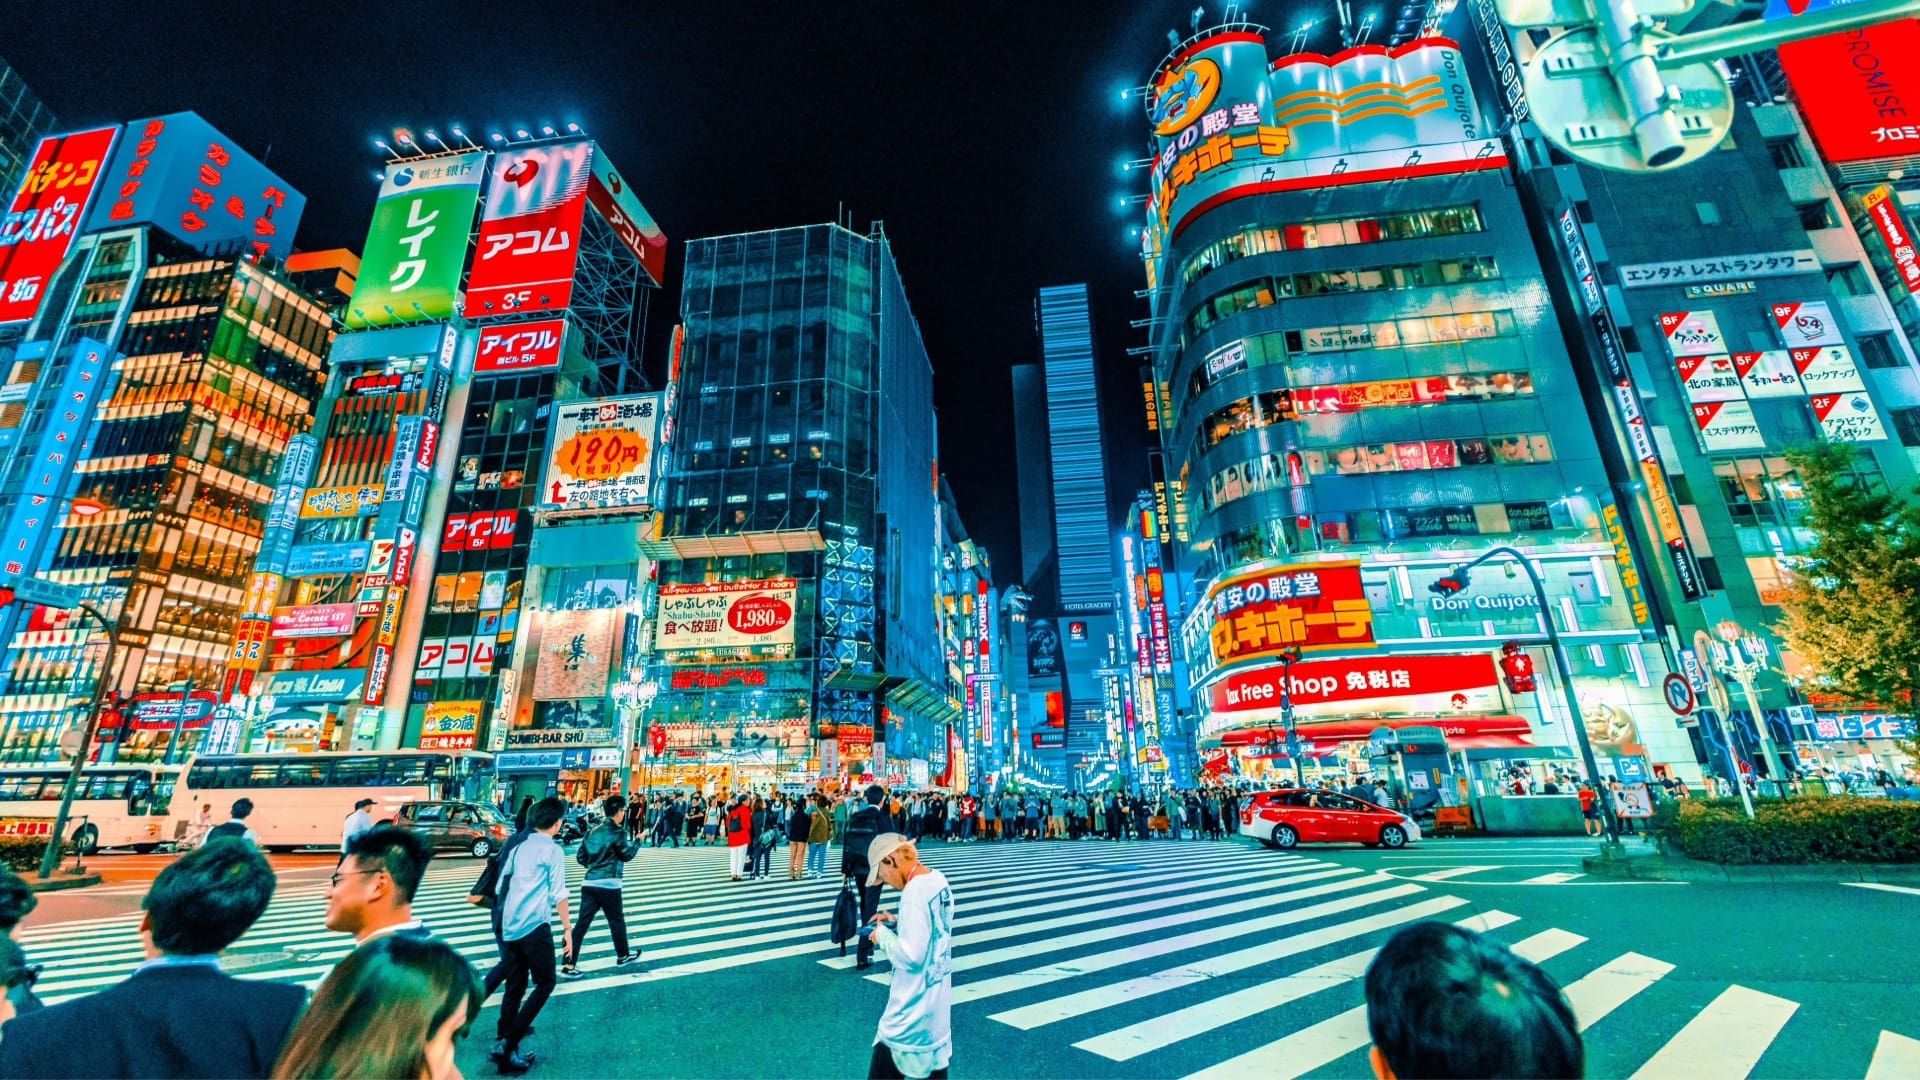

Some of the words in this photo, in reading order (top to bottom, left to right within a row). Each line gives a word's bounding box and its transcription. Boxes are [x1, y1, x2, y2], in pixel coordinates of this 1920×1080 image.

[1844, 28, 1908, 119] PROMISE
[1440, 50, 1457, 78] Don
[1452, 84, 1476, 139] Quijote
[1870, 126, 1920, 143] プロミ
[18, 159, 99, 195] パチンコ
[418, 162, 473, 179] 新生銀行
[610, 204, 646, 260] アコム
[390, 199, 439, 292] レイク
[482, 227, 570, 260] アコム
[1626, 266, 1686, 281] エンタメ
[1691, 256, 1813, 276] レストランタワー
[1691, 281, 1756, 294] SQUARE
[501, 290, 532, 310] 3F
[1774, 306, 1792, 317] 9F
[1662, 315, 1678, 327] 8F
[482, 329, 559, 355] アイフル
[521, 353, 536, 363] 5F
[1735, 355, 1752, 365] 5F
[1794, 350, 1810, 362] 6F
[1678, 360, 1695, 371] 4F
[1687, 377, 1739, 389] 北の家族
[1804, 369, 1856, 380] ロックアップ
[1695, 405, 1710, 416] B1
[1814, 398, 1830, 409] 2F
[563, 403, 653, 423] 一軒め酒場
[1824, 416, 1877, 427] アラビアン
[1704, 426, 1759, 437] ミステリアス
[570, 434, 639, 466] 190円
[569, 487, 639, 502] 左の路地を右へ
[447, 515, 516, 538] アイフル
[763, 581, 769, 589] 2
[664, 595, 728, 611] しゃぶしゃぶ
[1084, 601, 1112, 609] GRACERY
[1432, 596, 1470, 611] Don
[664, 619, 724, 635] 食べ放題!
[735, 609, 775, 629] 1,980
[978, 594, 989, 643] SHIDAX
[420, 642, 494, 667] アコム
[1346, 669, 1411, 690] 免税店
[1226, 687, 1240, 705] Tax
[1242, 682, 1274, 701] Free
[1279, 675, 1338, 697] Shop
[438, 713, 475, 731] 金の蔵
